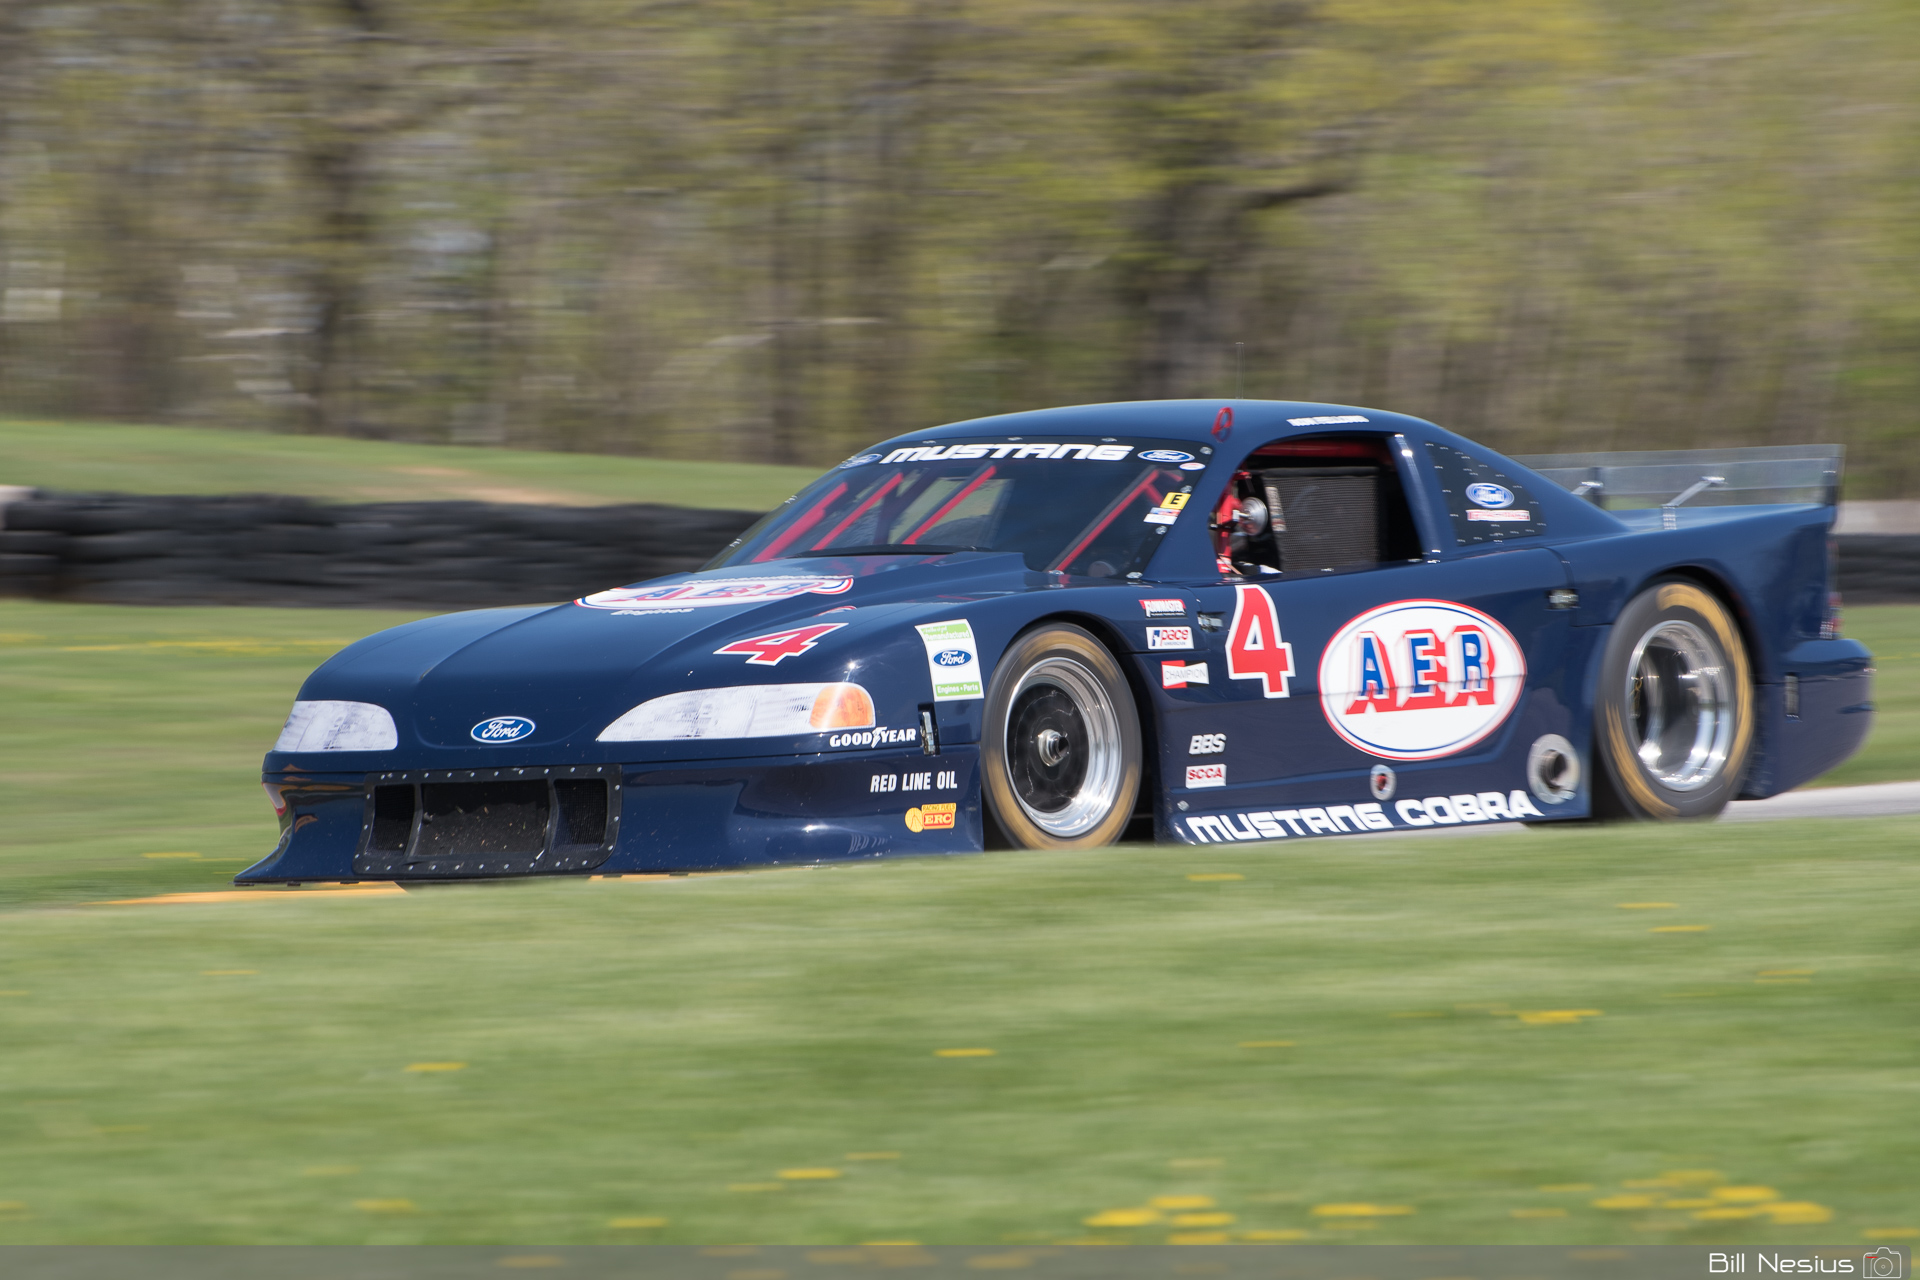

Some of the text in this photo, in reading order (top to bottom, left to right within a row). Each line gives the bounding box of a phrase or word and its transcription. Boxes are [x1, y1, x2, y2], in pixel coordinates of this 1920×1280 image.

[879, 443, 1134, 464] MUSTANG
[1169, 494, 1183, 505] E
[713, 623, 849, 666] 4
[1159, 629, 1189, 647] pace
[1225, 584, 1296, 699] 4
[1164, 668, 1207, 681] CHAMPION
[1346, 626, 1496, 714] AER
[481, 718, 525, 739] Ford
[829, 726, 917, 749] GOODYEAR
[1188, 733, 1227, 756] BBS
[869, 770, 958, 793] RED LINE OIL
[1186, 766, 1224, 781] SCCA
[924, 813, 952, 825] ERC
[1186, 789, 1545, 843] MUSTANG COBRA
